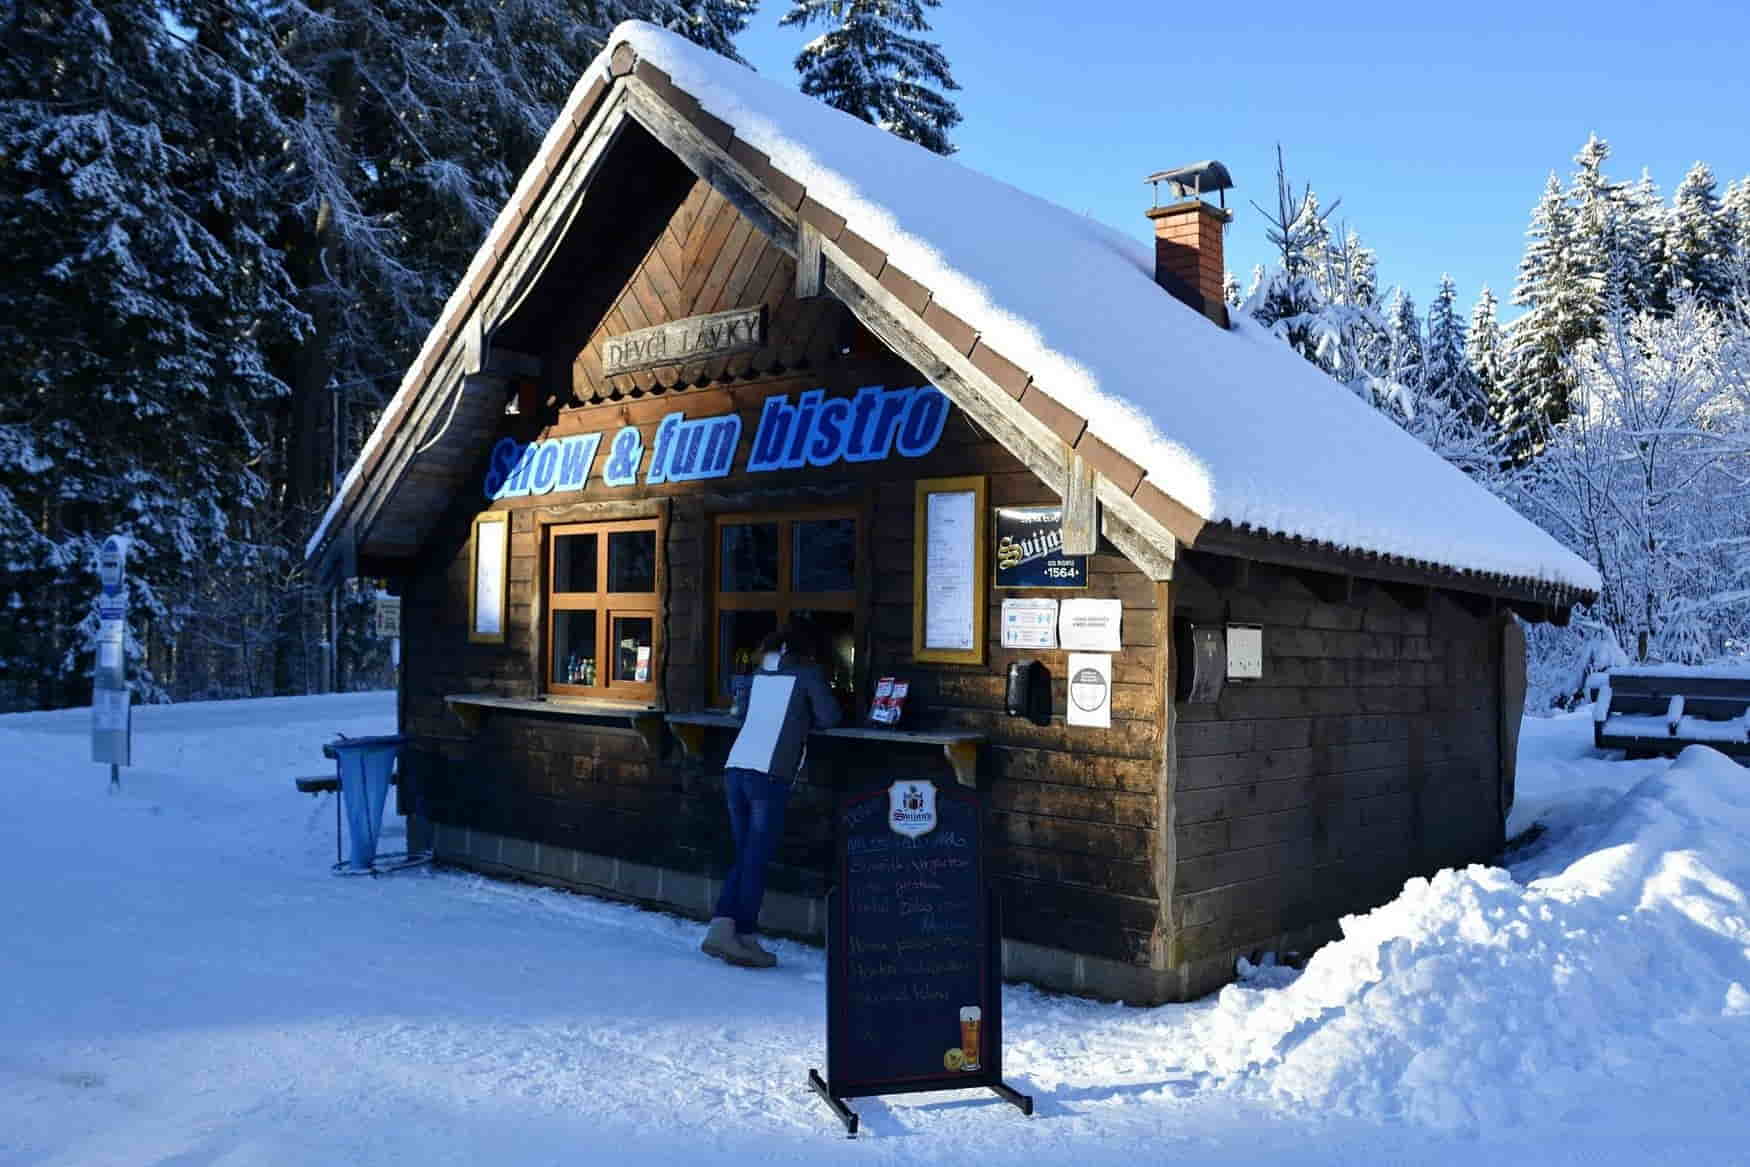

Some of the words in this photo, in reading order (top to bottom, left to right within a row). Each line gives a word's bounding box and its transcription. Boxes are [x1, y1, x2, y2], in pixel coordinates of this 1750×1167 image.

[484, 434, 603, 500] Snow
[603, 426, 643, 487] &
[646, 412, 742, 484] fun
[746, 385, 950, 472] bistro
[1047, 567, 1075, 578] 1564
